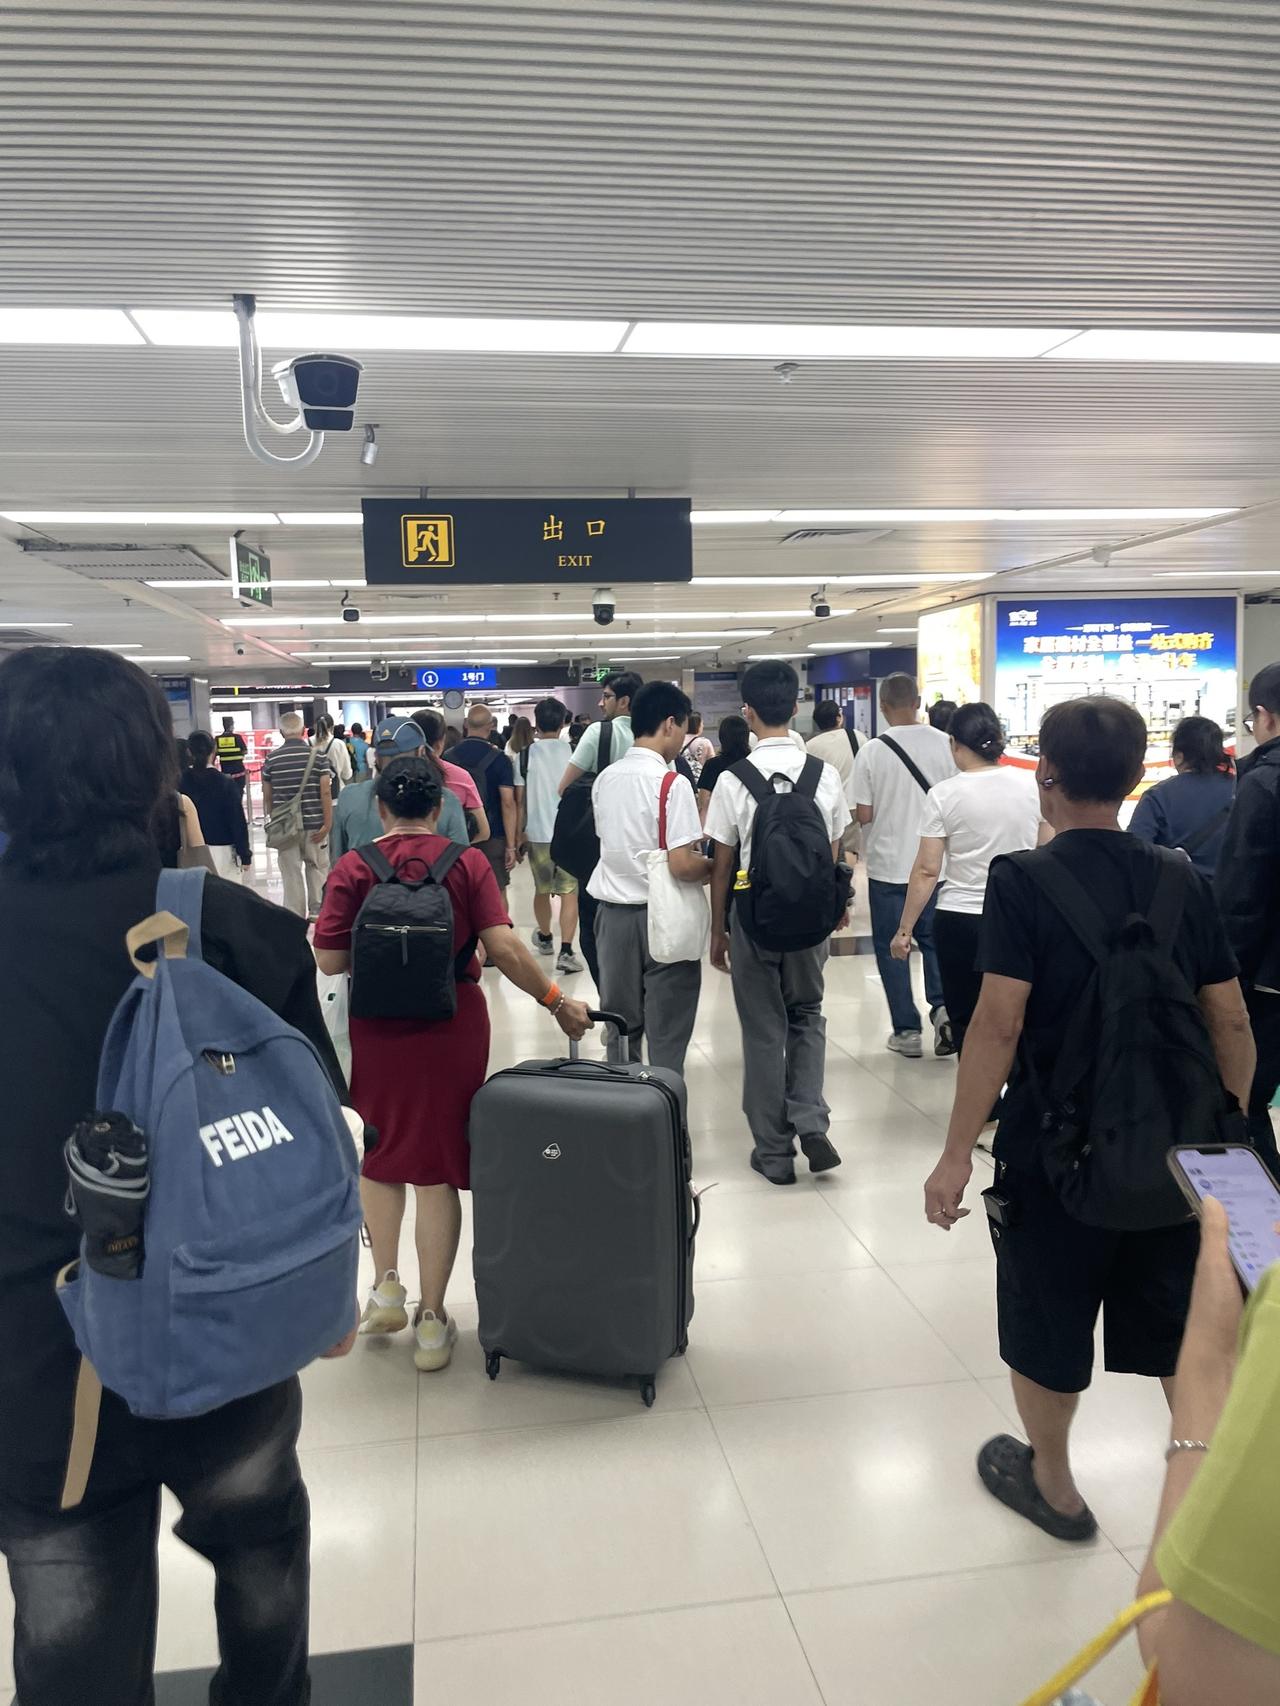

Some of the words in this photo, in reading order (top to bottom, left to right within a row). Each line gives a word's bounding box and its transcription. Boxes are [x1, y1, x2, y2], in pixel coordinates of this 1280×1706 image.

[543, 514, 606, 541] 出口
[558, 555, 593, 567] EXIT
[199, 1106, 295, 1168] FEIDA
